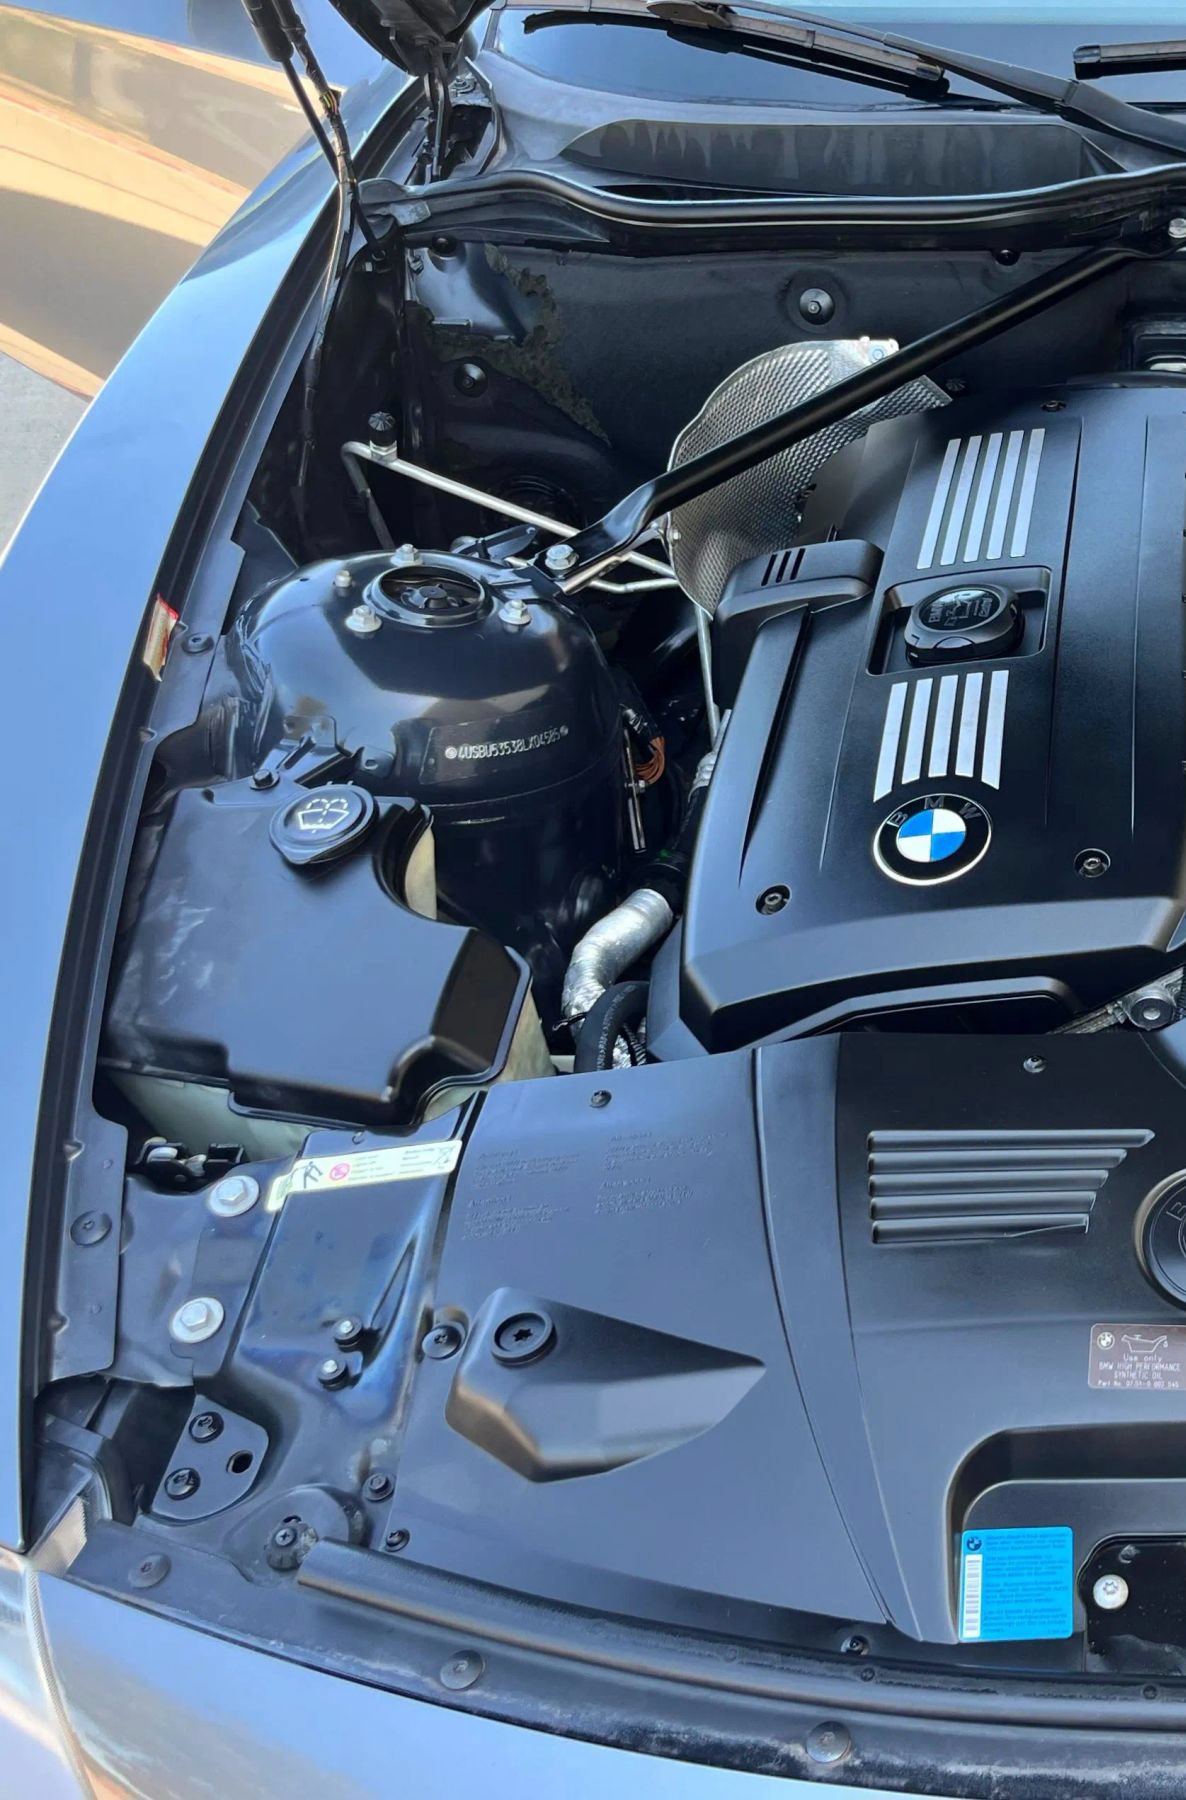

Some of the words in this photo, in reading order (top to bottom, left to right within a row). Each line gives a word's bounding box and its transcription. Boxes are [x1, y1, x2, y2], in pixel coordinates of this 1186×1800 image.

[886, 795, 982, 828] BMW
[1123, 1353, 1138, 1361] Use
[1144, 1353, 1162, 1362] only
[1098, 1361, 1114, 1370] BMW
